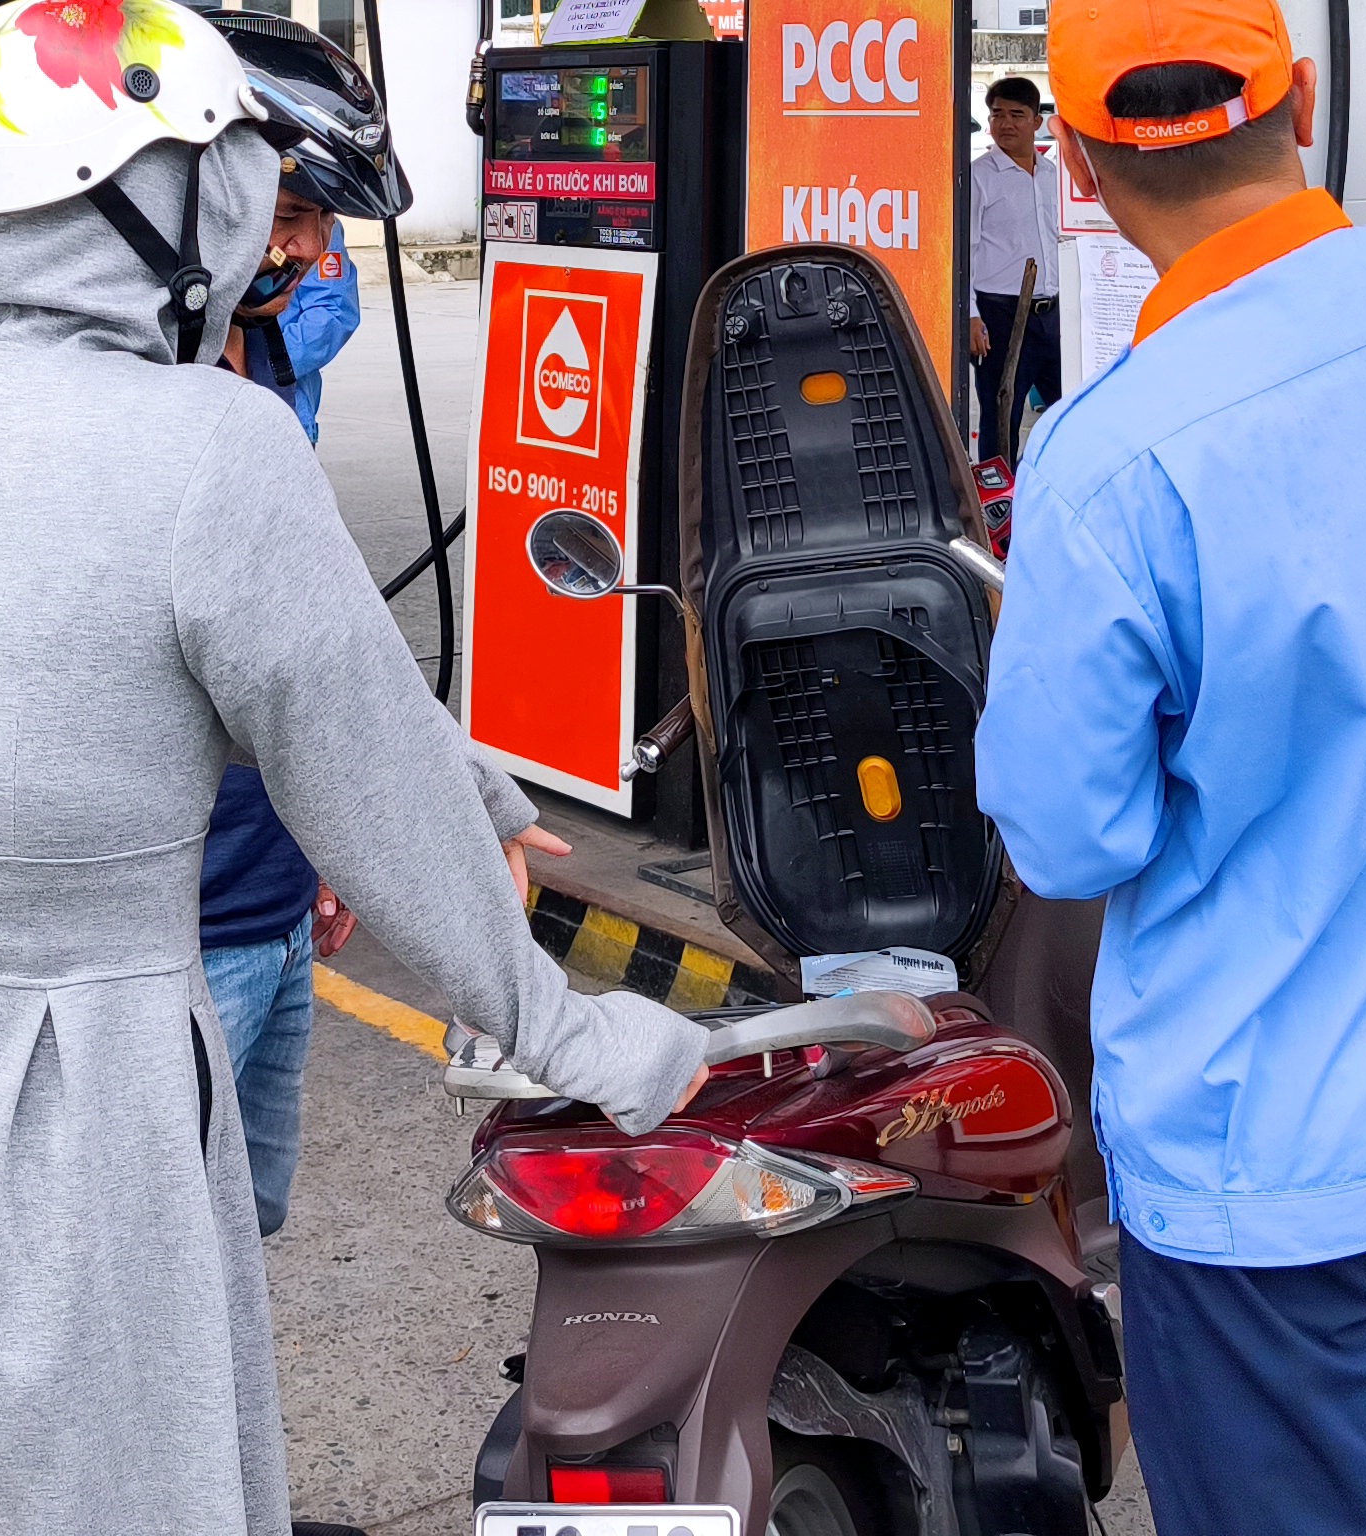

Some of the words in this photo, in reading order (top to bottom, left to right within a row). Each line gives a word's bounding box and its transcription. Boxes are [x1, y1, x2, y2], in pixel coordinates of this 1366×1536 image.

[782, 17, 919, 105] PCCC
[1134, 119, 1210, 140] COMECO
[491, 166, 514, 190] TRẢ
[517, 165, 533, 190] VỀ
[546, 169, 590, 192] TRƯỚC
[593, 174, 615, 192] KHI
[618, 173, 648, 193] BƠM
[782, 174, 919, 251] KHÁCH
[539, 368, 591, 395] COMECO
[488, 465, 523, 496] ISO
[527, 472, 566, 505] 9001
[581, 484, 618, 517] 2015
[561, 1311, 661, 1327] HONDA
